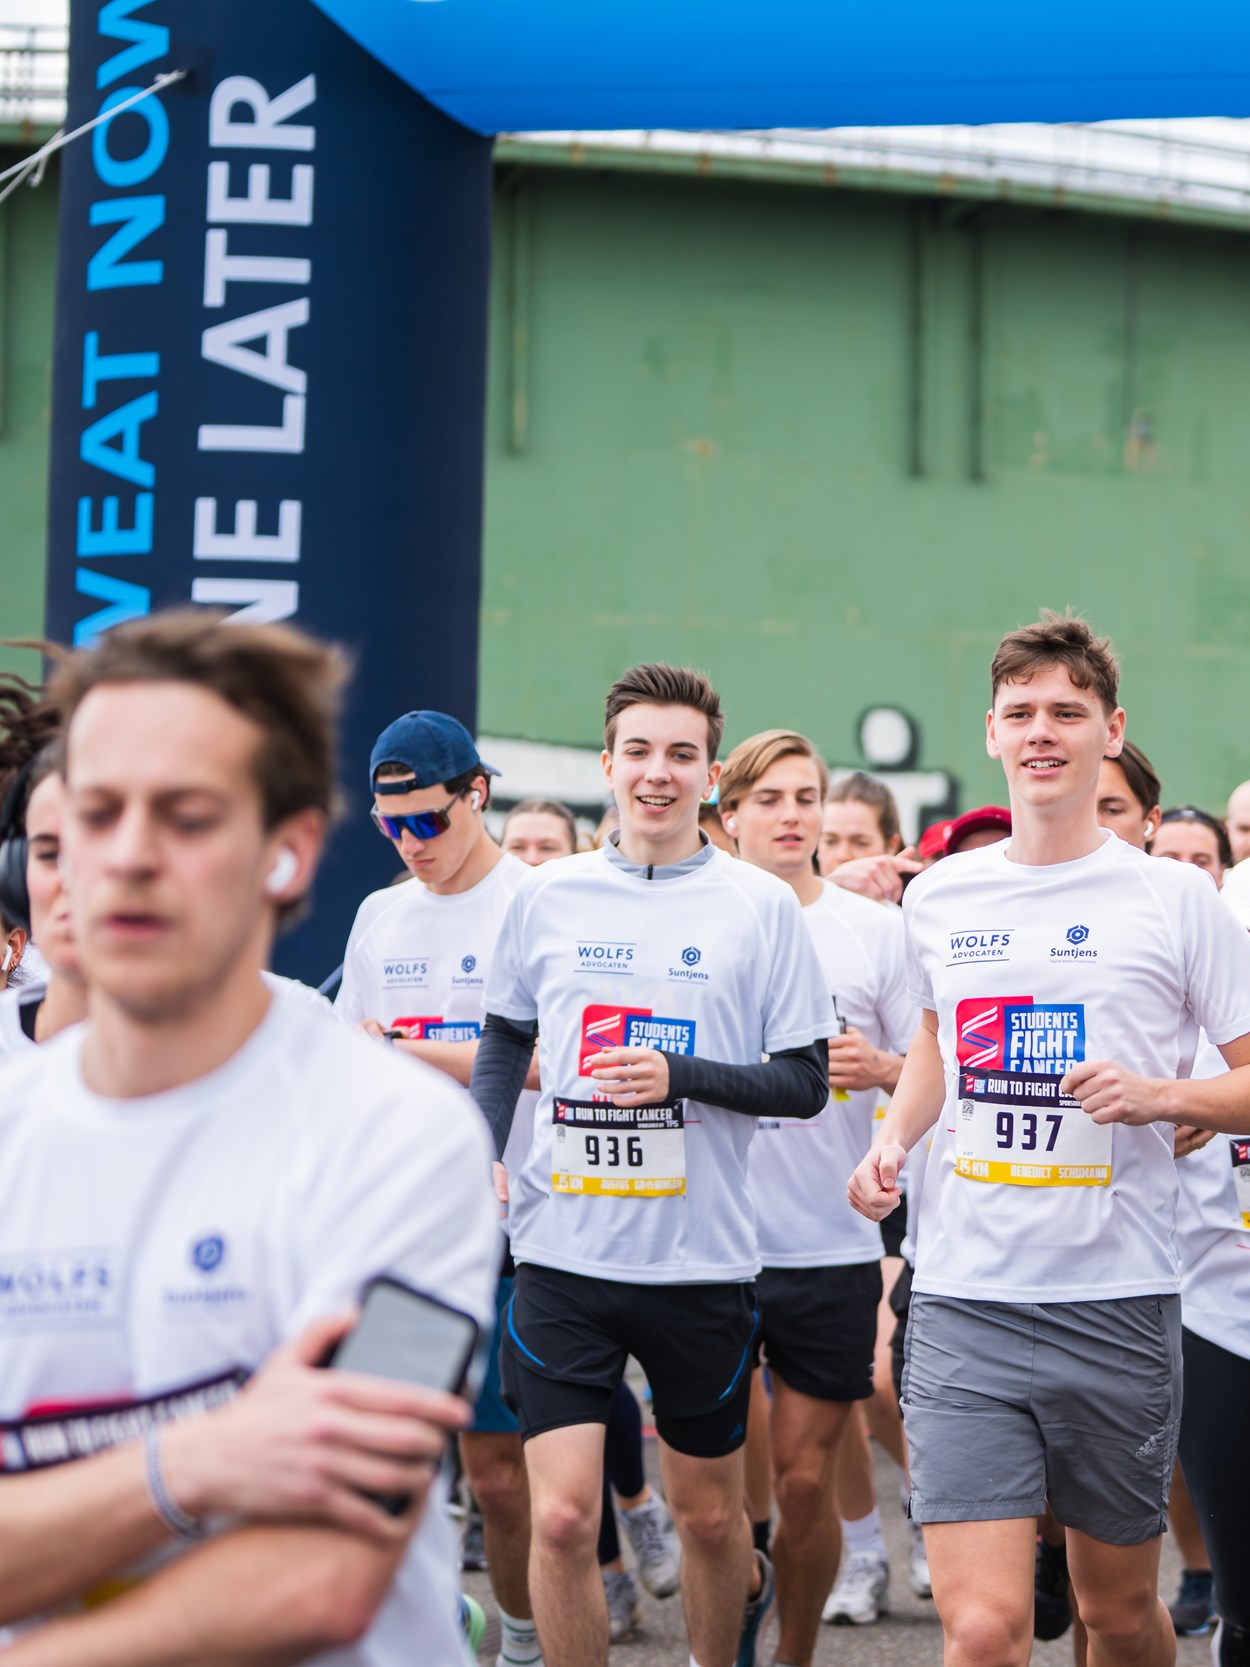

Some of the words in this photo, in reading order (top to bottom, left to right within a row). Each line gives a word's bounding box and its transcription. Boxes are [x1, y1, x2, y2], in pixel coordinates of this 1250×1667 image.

[87, 0, 170, 291] NOW
[198, 73, 317, 454] LATER
[951, 934, 1010, 950] WOLFS
[578, 946, 634, 960] WOLFS
[953, 949, 1004, 959] ADVOCATEN
[1050, 947, 1098, 959] Suntjens
[384, 963, 428, 975] WOLFS
[581, 961, 628, 969] ADVOCATEN
[667, 968, 709, 981] Suntjens
[1011, 1012, 1078, 1030] STUDENTS
[630, 1021, 690, 1041] STUDENTS
[1010, 1030, 1078, 1058] FIGHT
[987, 1079, 1008, 1094] RUN
[1009, 1081, 1023, 1095] TO
[1024, 1082, 1057, 1097] FIGHT
[575, 1107, 594, 1120] RUN
[595, 1108, 607, 1121] TO
[608, 1109, 634, 1121] FIGHT
[636, 1108, 673, 1121] CANCER
[996, 1111, 1063, 1151] 937
[585, 1135, 643, 1167] 936
[972, 1161, 989, 1177] KM
[1010, 1165, 1053, 1178] BENEDICT
[1058, 1167, 1107, 1179] SCHUMANN
